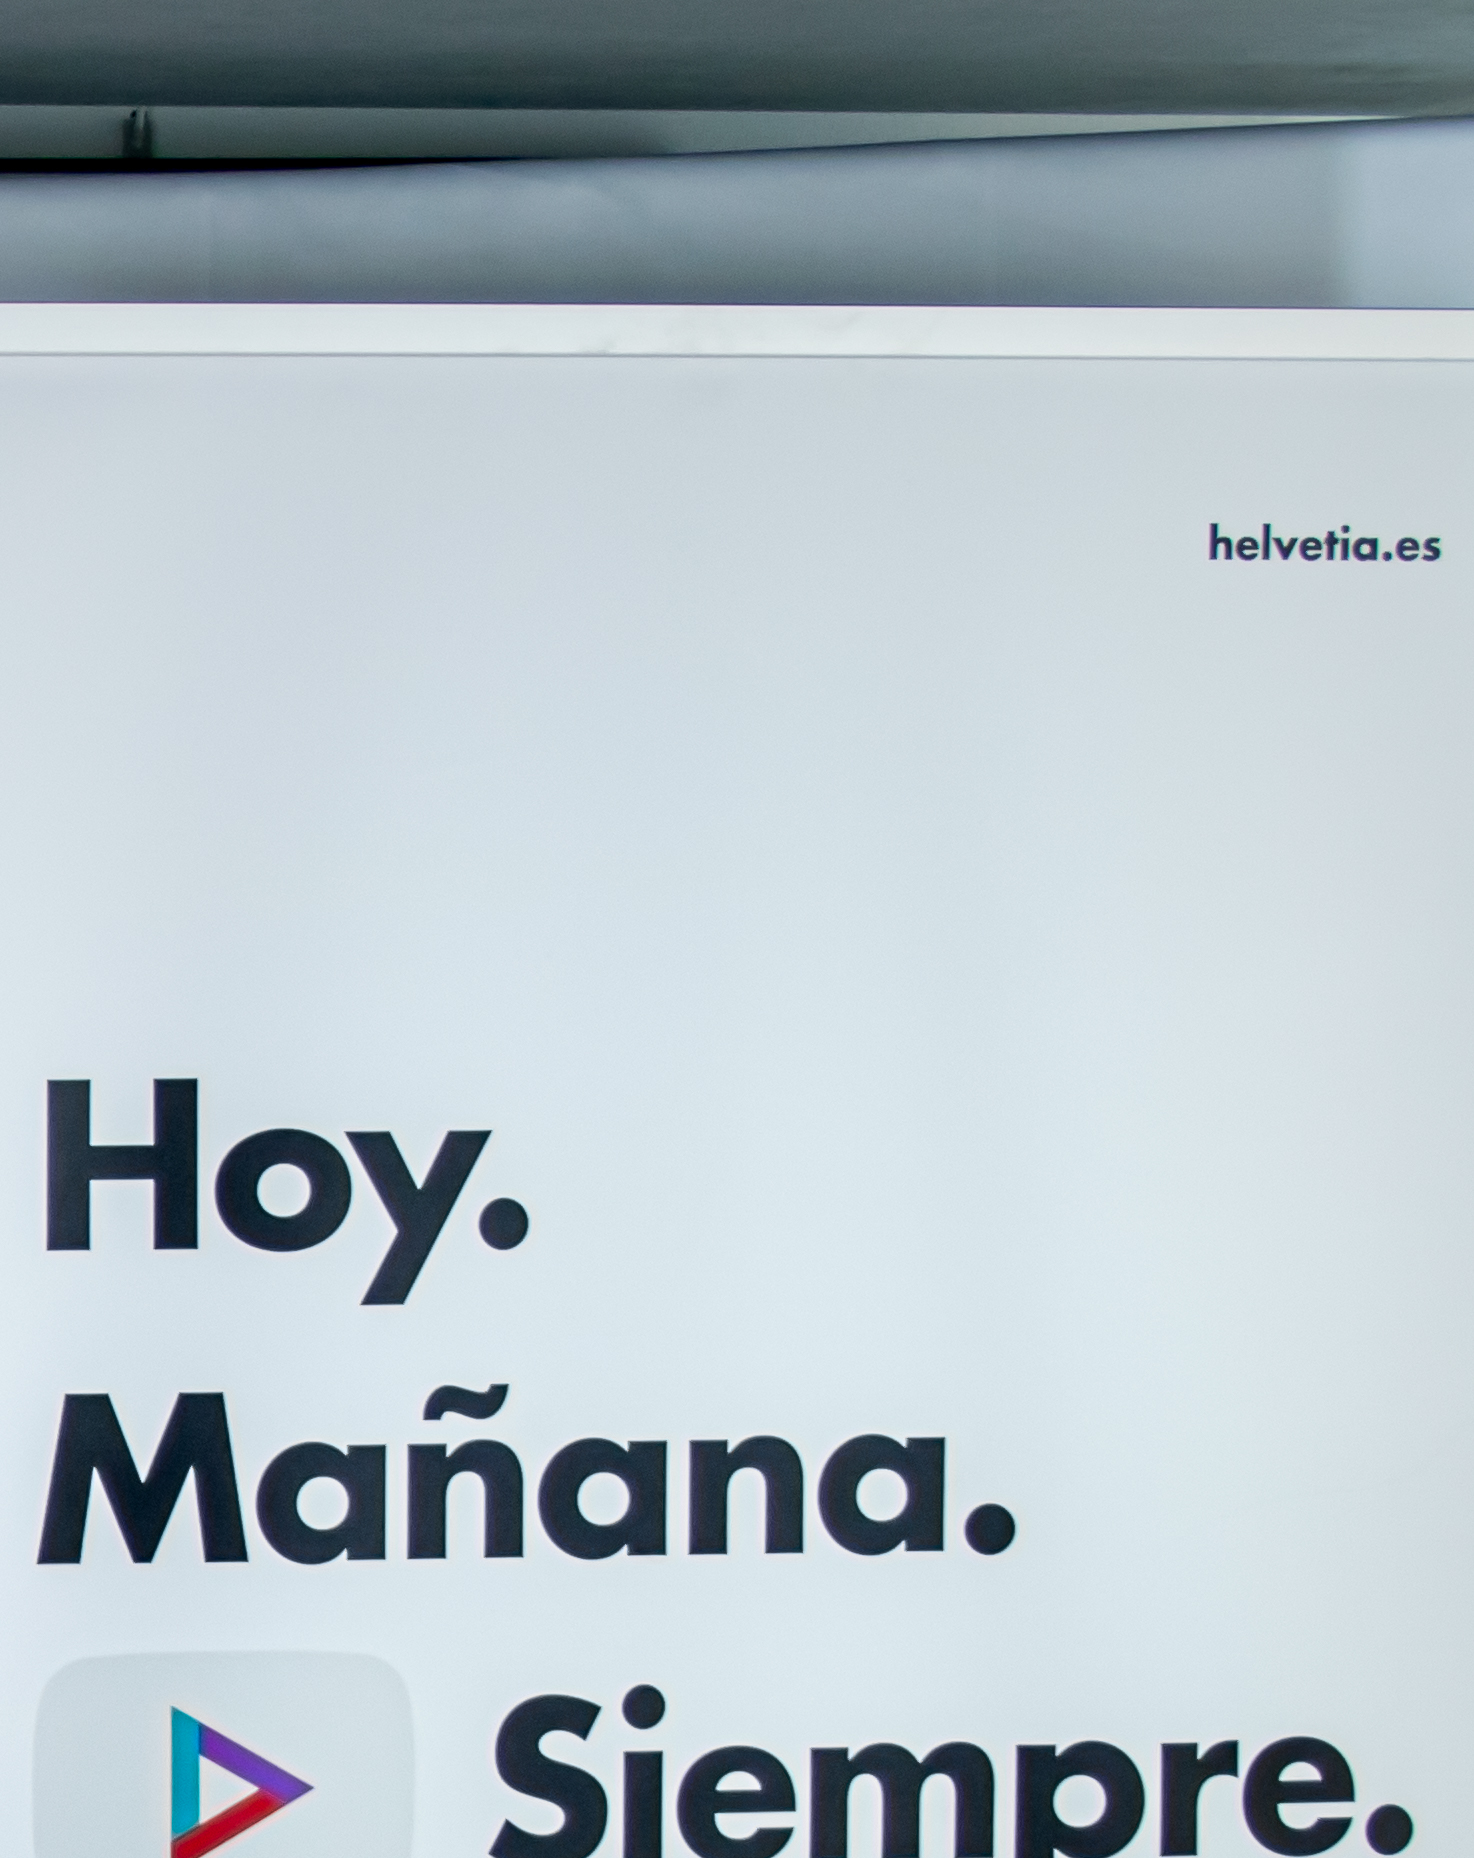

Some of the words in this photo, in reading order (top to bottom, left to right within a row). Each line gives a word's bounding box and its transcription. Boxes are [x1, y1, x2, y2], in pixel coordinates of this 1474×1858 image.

[1209, 523, 1441, 562] helvetia.es
[46, 1078, 529, 1306] Hoy.
[36, 1384, 1016, 1565] Mañana.
